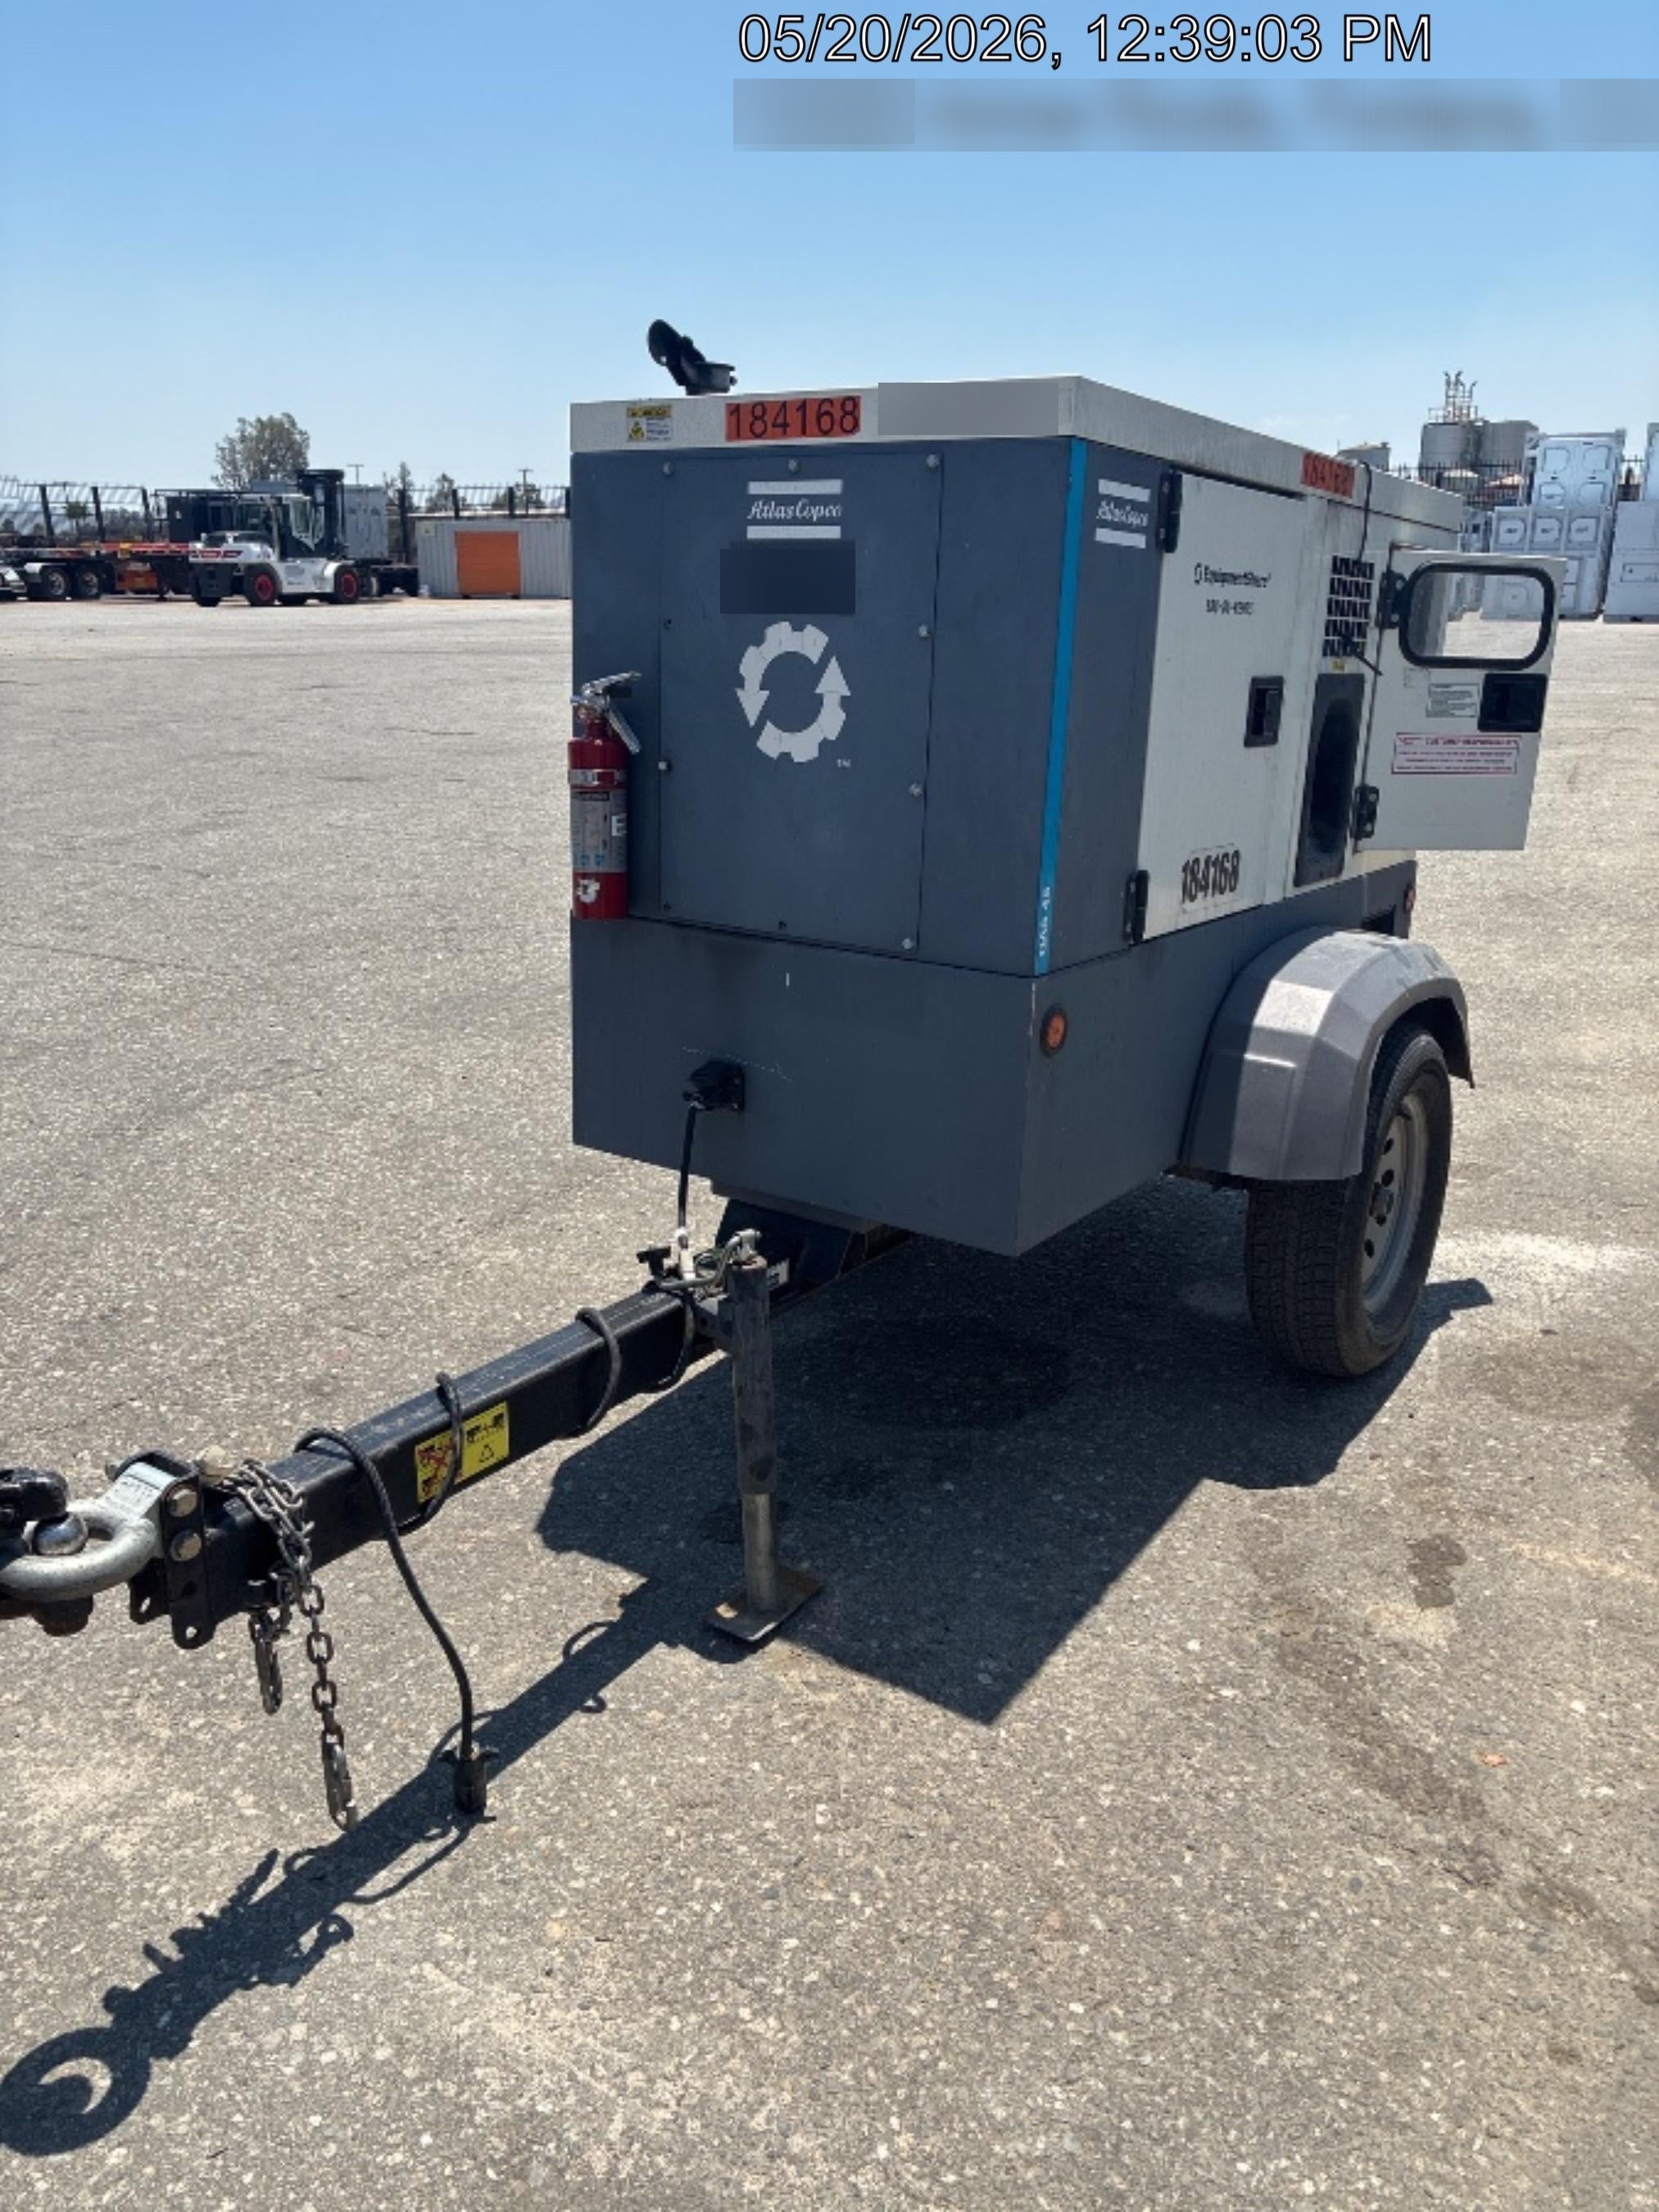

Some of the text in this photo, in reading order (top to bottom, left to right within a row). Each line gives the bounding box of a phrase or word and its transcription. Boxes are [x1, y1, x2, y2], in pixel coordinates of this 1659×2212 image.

[729, 396, 859, 438] 184168
[747, 497, 842, 522] Atlas Copco
[1182, 850, 1240, 904] 184168
